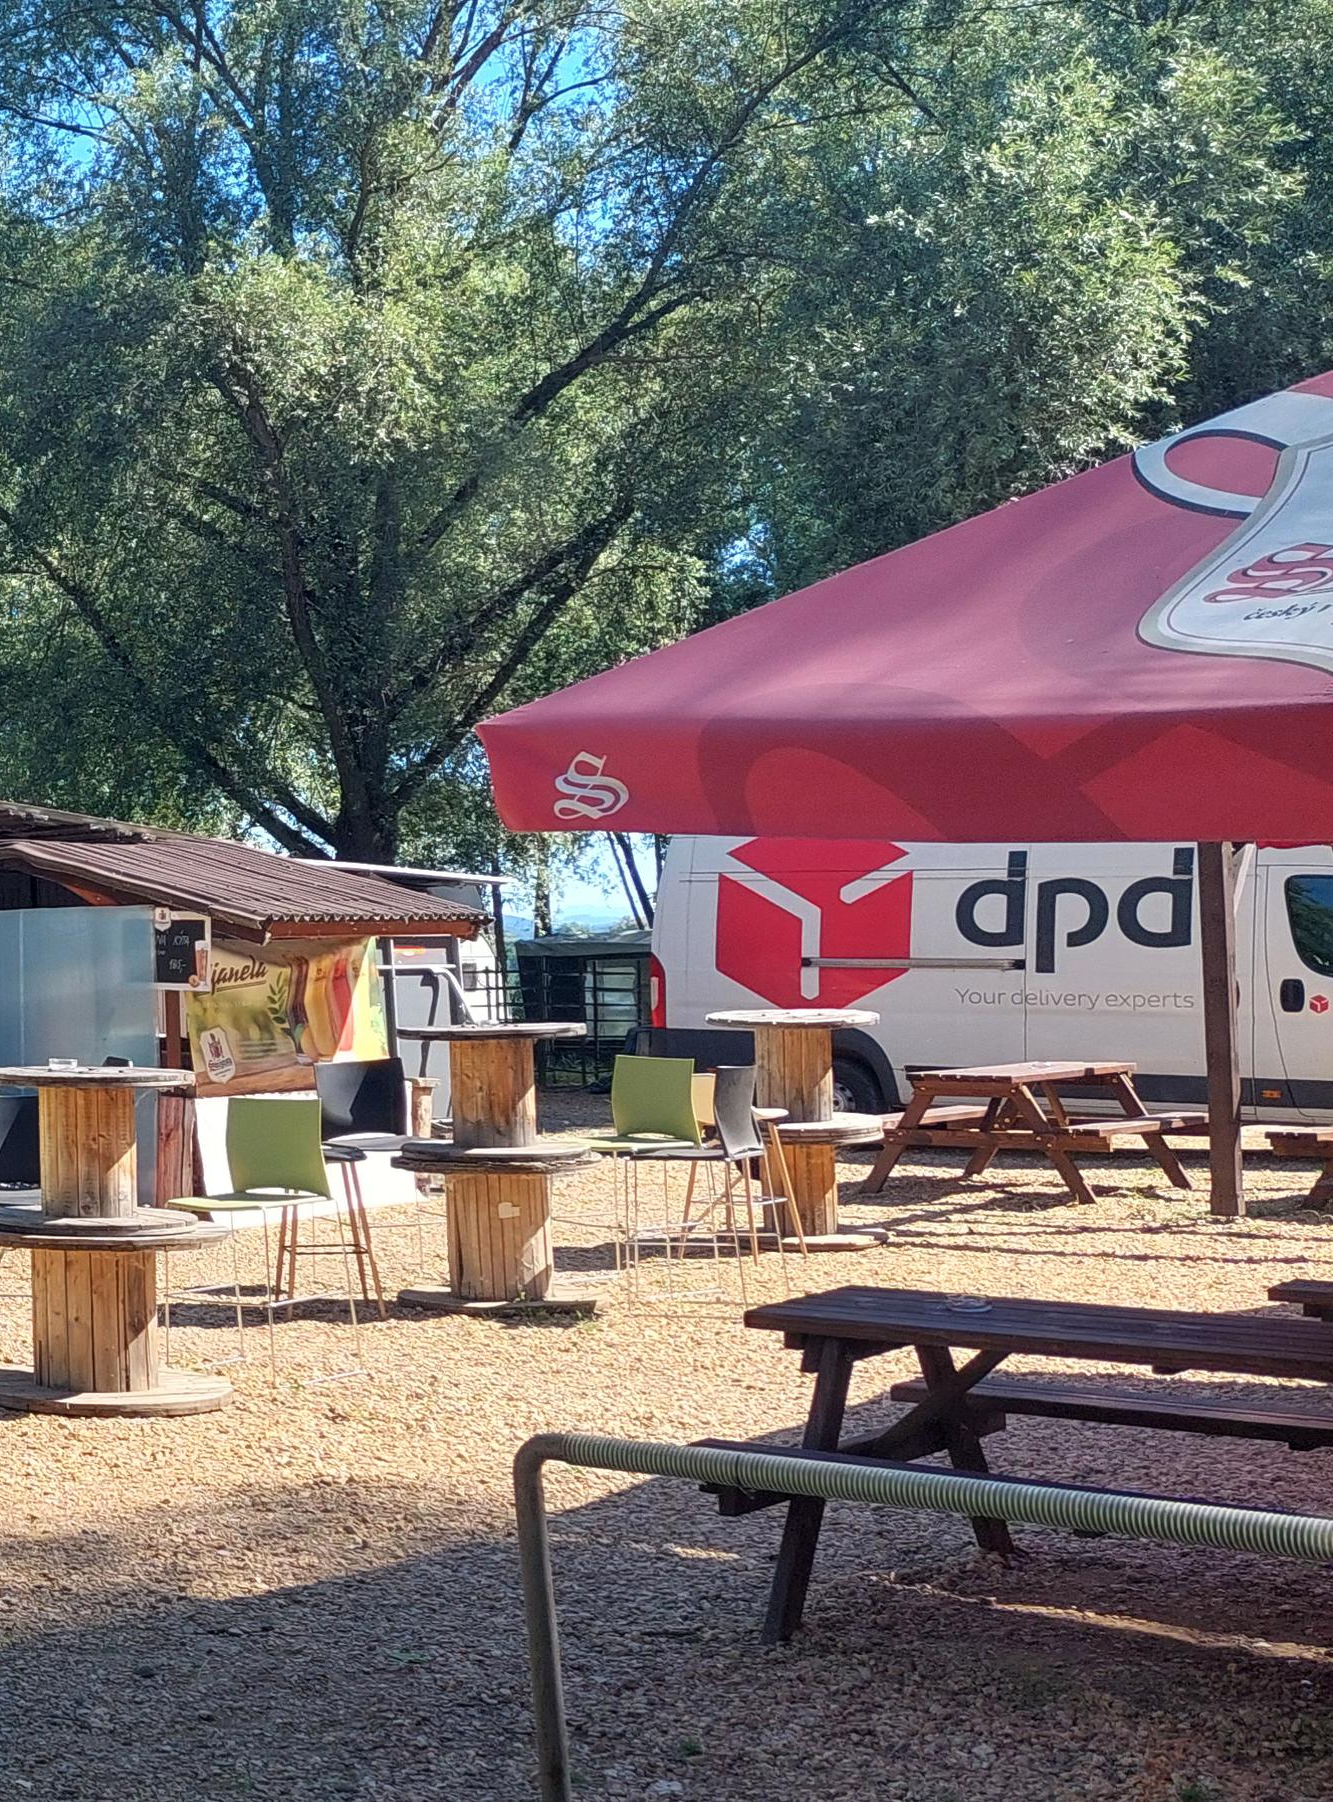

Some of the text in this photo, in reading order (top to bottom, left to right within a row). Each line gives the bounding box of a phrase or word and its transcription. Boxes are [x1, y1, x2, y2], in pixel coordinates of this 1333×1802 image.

[955, 847, 1194, 974] dpd
[211, 954, 268, 995] janela
[955, 988, 1195, 1011] Your delivery experts
